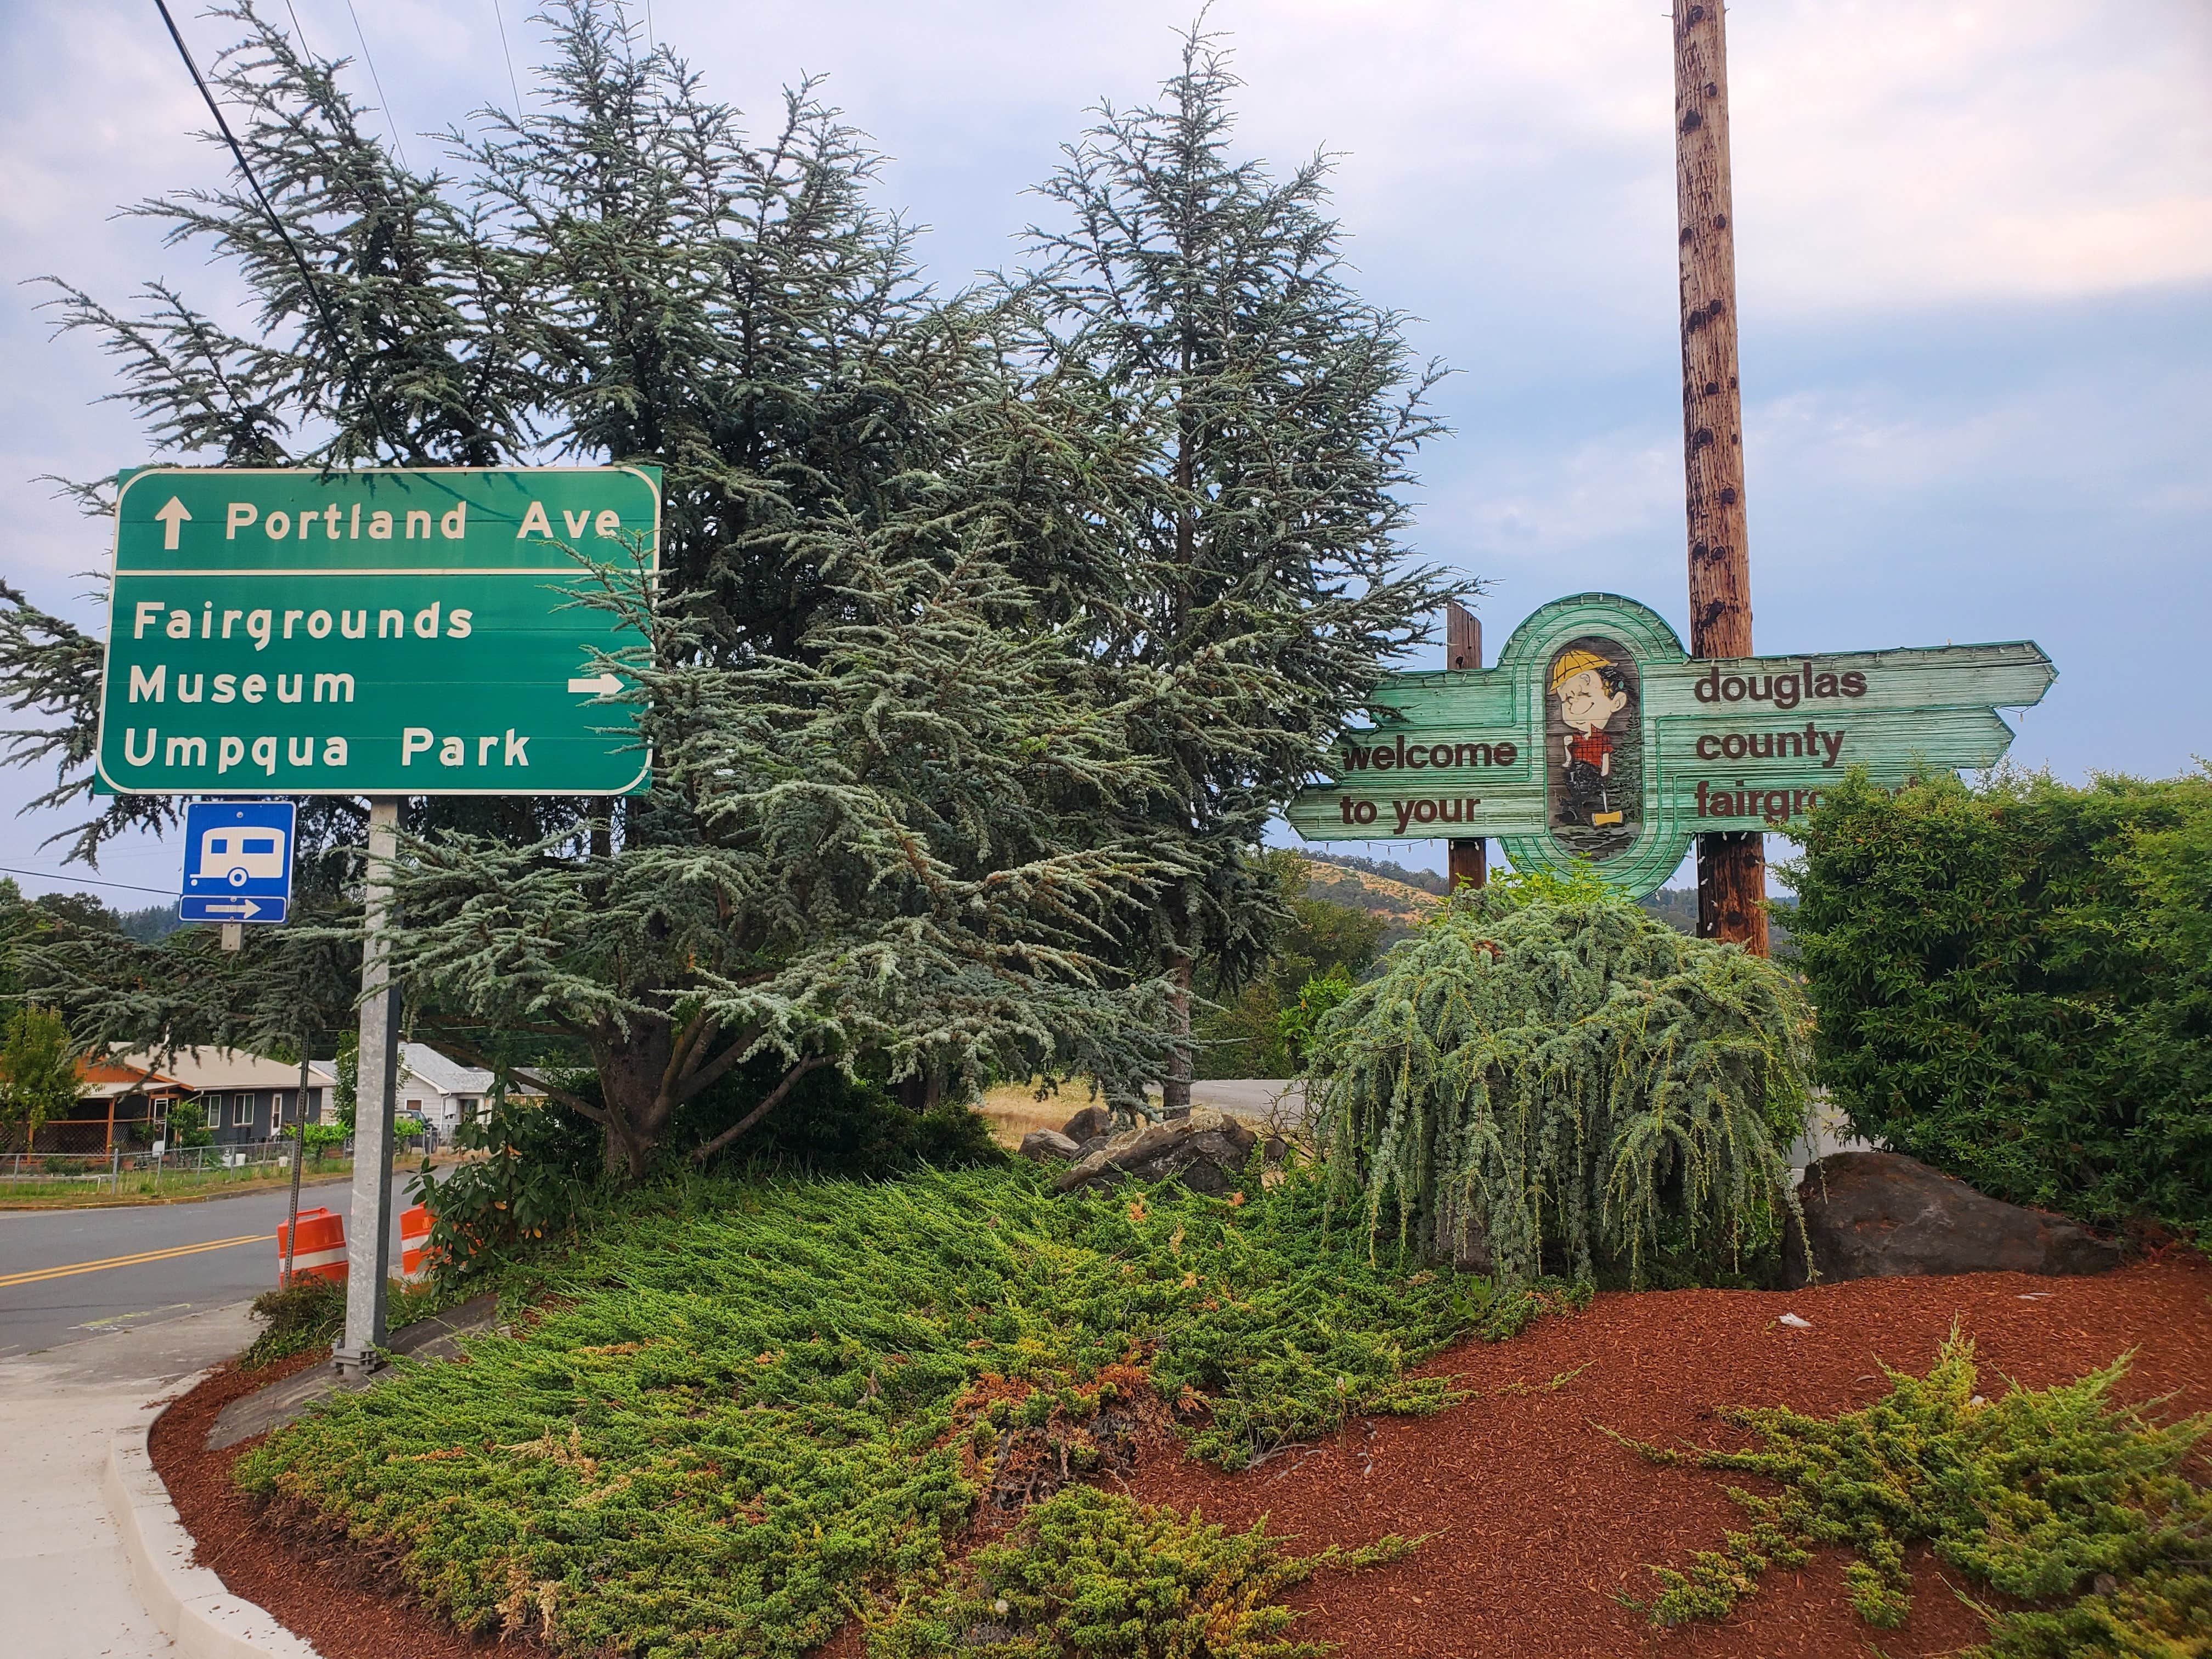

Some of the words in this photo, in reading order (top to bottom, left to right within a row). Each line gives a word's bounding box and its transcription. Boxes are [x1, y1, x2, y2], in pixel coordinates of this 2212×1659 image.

[226, 501, 466, 540] Portland
[516, 501, 620, 539] Ave
[134, 601, 473, 651] Fairgrounds
[129, 665, 355, 703] Museum
[1694, 662, 1867, 709] douglas
[125, 728, 348, 776] Umpqua
[402, 727, 530, 766] Park
[1343, 735, 1517, 770] welcome
[1696, 722, 1846, 768] county
[1340, 796, 1377, 824] to
[1392, 798, 1481, 834] your
[1695, 776, 1918, 823] fairgr
